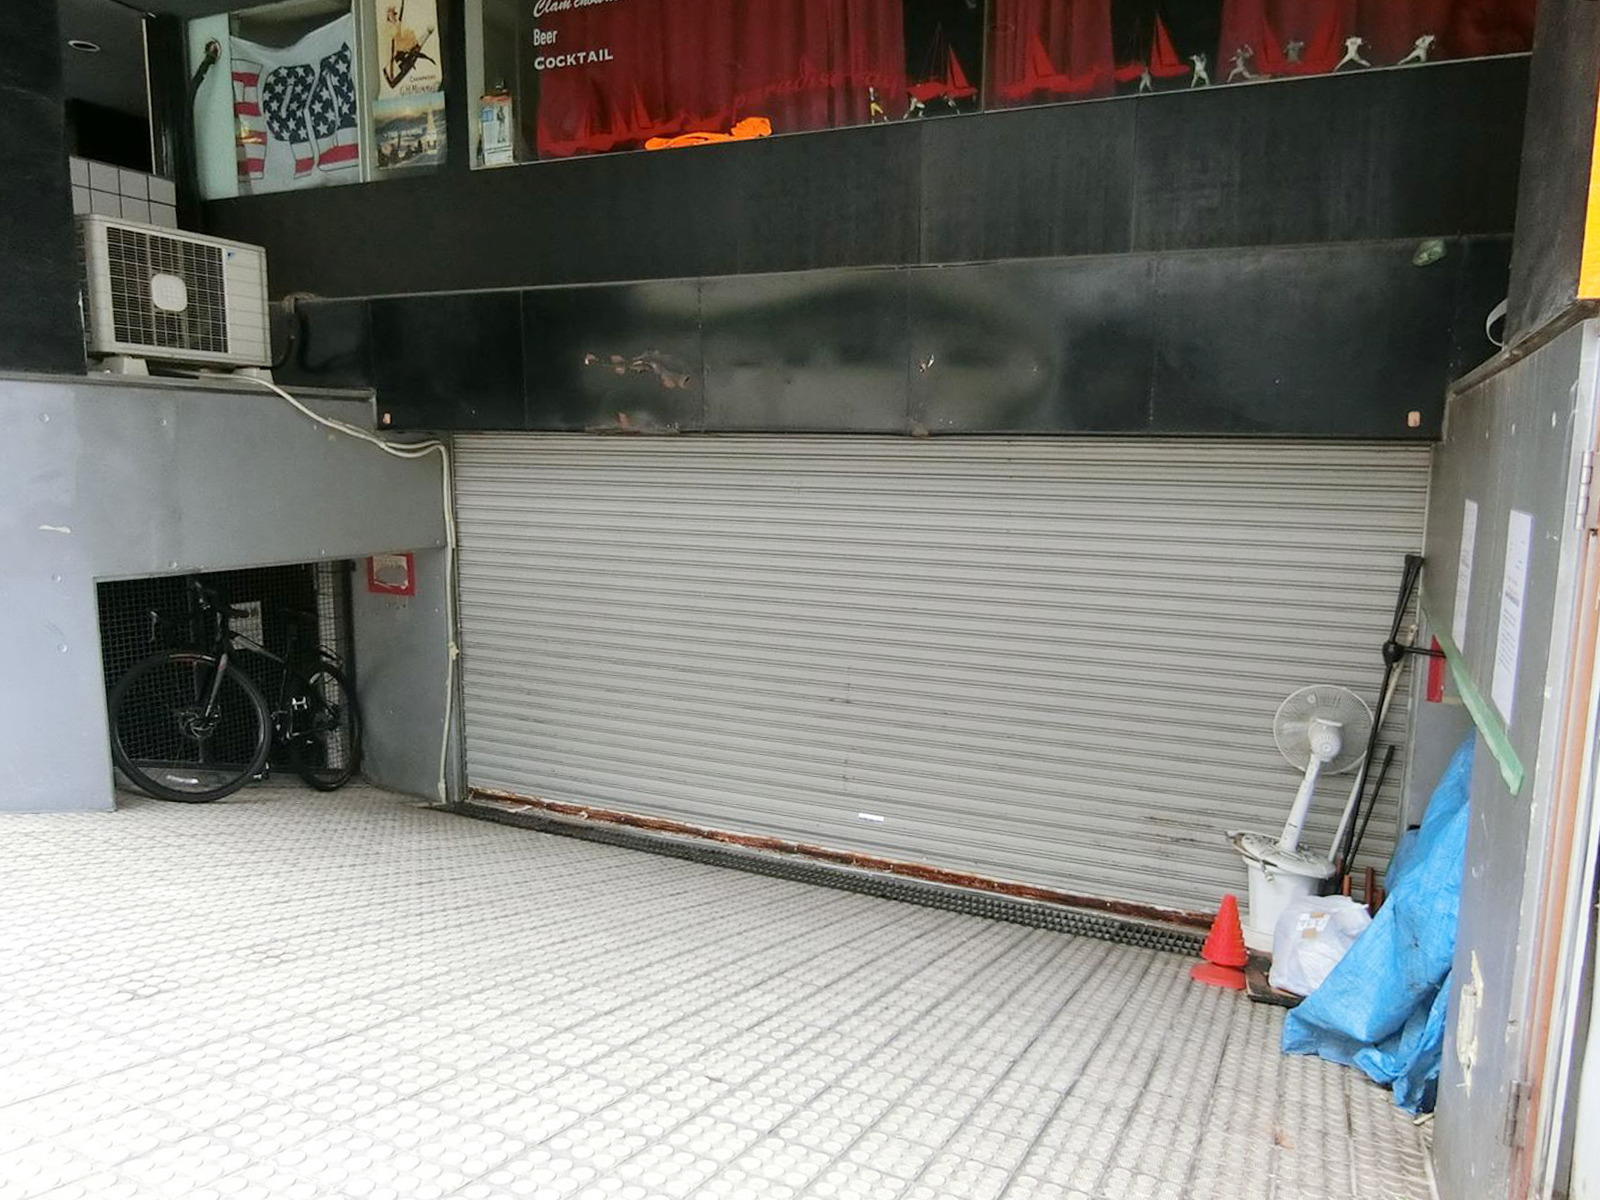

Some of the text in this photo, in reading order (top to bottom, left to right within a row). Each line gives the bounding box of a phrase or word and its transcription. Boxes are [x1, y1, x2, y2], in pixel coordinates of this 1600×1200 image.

[533, 0, 571, 17] Clam
[533, 28, 558, 46] Beer
[534, 48, 614, 70] COCKTAIL
